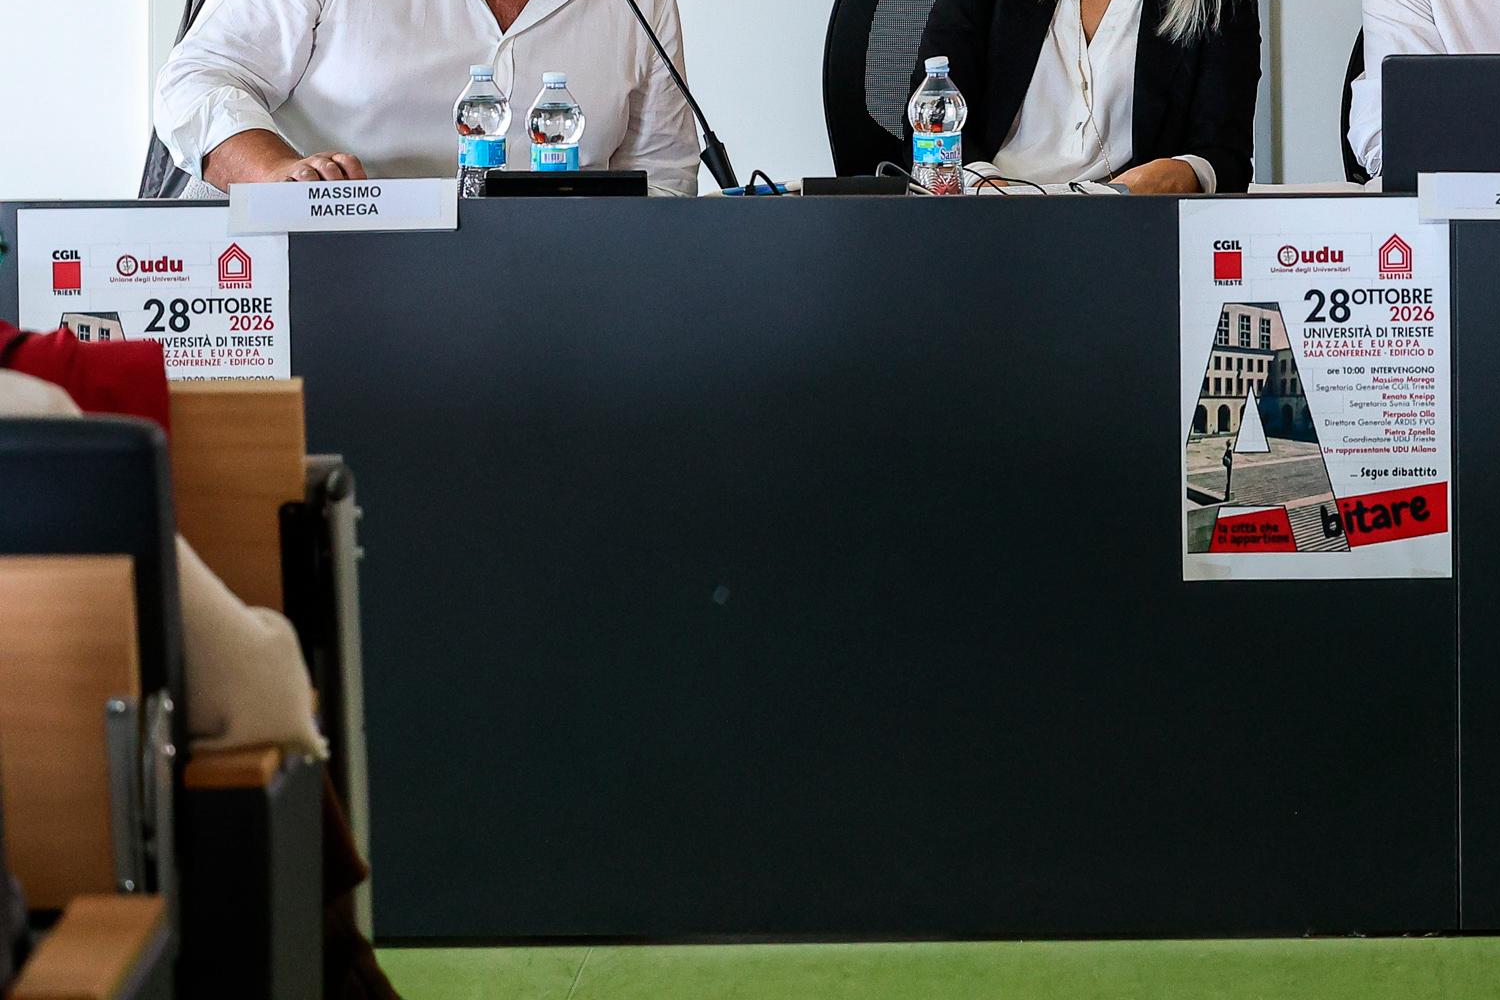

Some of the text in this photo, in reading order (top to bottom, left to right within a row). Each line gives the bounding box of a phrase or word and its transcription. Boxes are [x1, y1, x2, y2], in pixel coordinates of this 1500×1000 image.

[308, 185, 382, 200] MASSIMO
[310, 203, 379, 217] MAREGA
[1213, 240, 1242, 251] CGIL
[52, 250, 81, 260] CGIL
[1301, 246, 1344, 263] udu
[140, 256, 183, 273] udu
[1295, 266, 1312, 274] degli
[134, 276, 151, 284] degli
[152, 275, 190, 283] Universitari
[218, 282, 252, 290] sunia
[1304, 288, 1433, 324] 28 OTTOBRE
[143, 297, 273, 333] 28 OTTOBRE
[1389, 305, 1435, 322] 2026
[229, 315, 275, 332] 2026
[1303, 325, 1434, 339] UNIVERSITÀ DI TRIESTE
[143, 334, 274, 348] IVERSITÀ DI TRIESTE
[1303, 339, 1420, 349] PIAZZALE EUROPA
[165, 348, 260, 358] ZZALE EUROPA
[1303, 350, 1324, 358] SALA
[1326, 349, 1382, 357] CONFERENZE
[1389, 349, 1425, 357] EDIFICIO
[166, 359, 221, 367] CONFERENZE
[229, 358, 265, 366] EDIFICIO
[268, 358, 274, 366] D
[1370, 366, 1435, 374] INTERVENGONO
[1372, 376, 1435, 385] Massimo Marega
[1316, 383, 1354, 392] Segretario
[1355, 383, 1390, 391] Generale
[1409, 393, 1435, 401] Kneipp
[1349, 400, 1387, 408] Segretario
[1382, 411, 1417, 419] Pierpaolo
[1324, 419, 1356, 427] Direttore
[1394, 418, 1417, 426] ARDIS
[1419, 418, 1435, 426] FVG
[1384, 428, 1436, 436] Pietro Zanella
[1342, 435, 1391, 443] Coordinatore
[1335, 446, 1391, 455] rappresentante
[1360, 467, 1389, 480] Segue
[1391, 467, 1437, 477] dibattito
[1319, 495, 1431, 539] bitare
